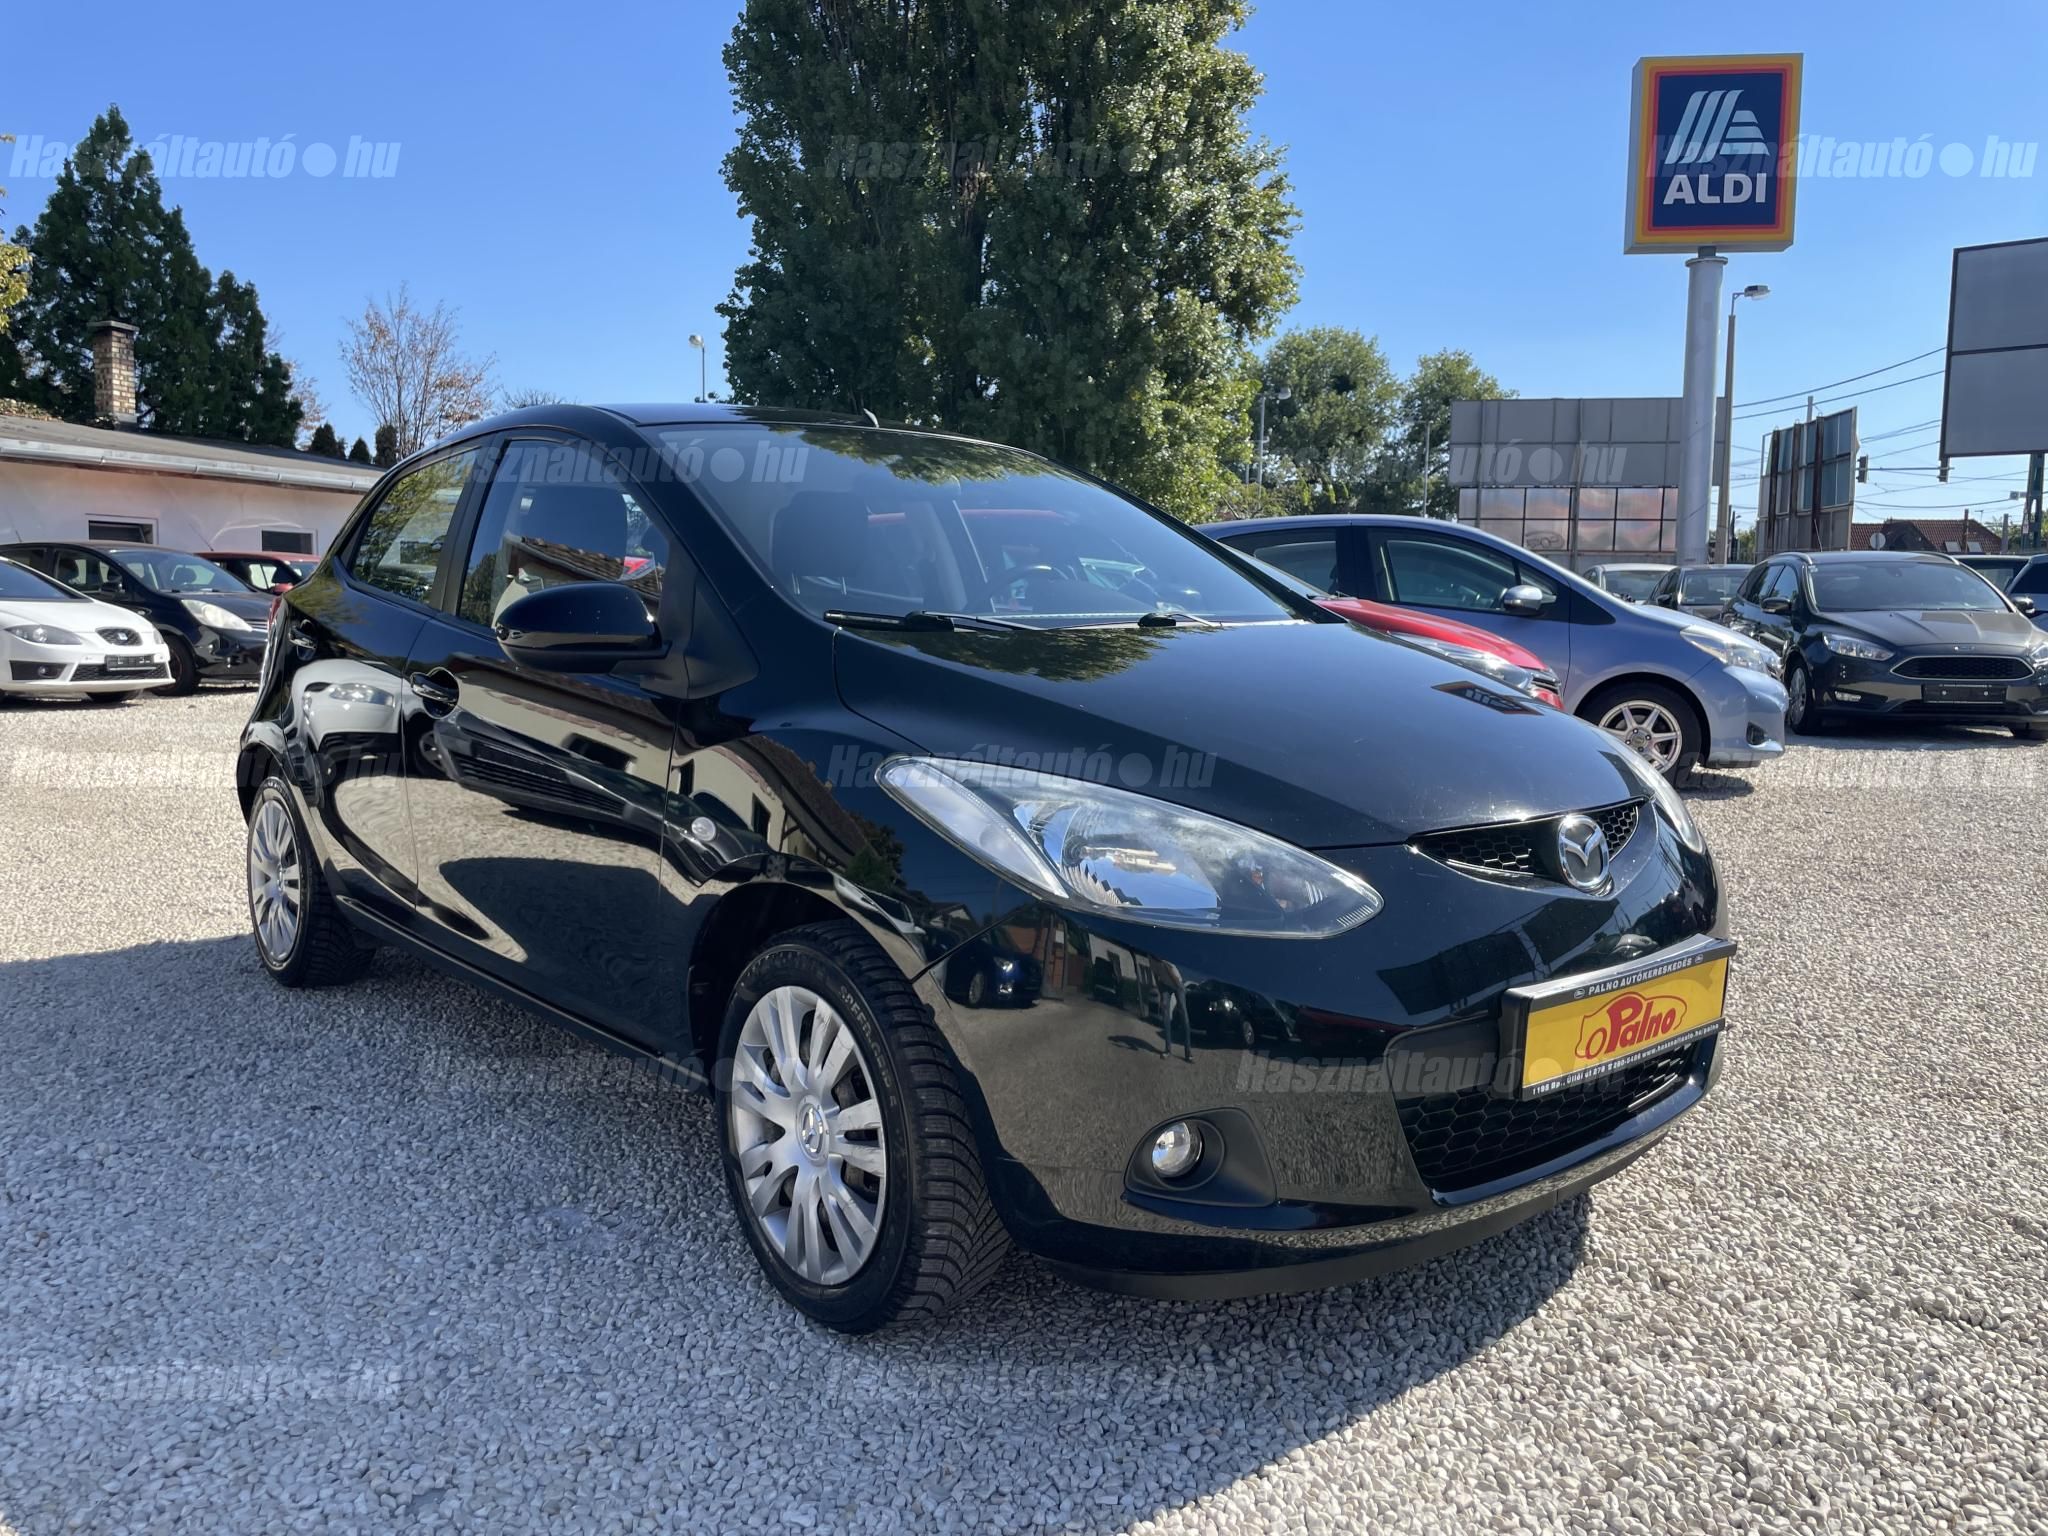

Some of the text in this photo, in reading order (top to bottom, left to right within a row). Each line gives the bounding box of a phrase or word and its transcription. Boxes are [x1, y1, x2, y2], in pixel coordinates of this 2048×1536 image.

[1662, 172, 1767, 206] ALDI
[1588, 957, 1692, 995] PALNO AUTÓKERESKEDÉS
[1604, 993, 1677, 1054] Palno
